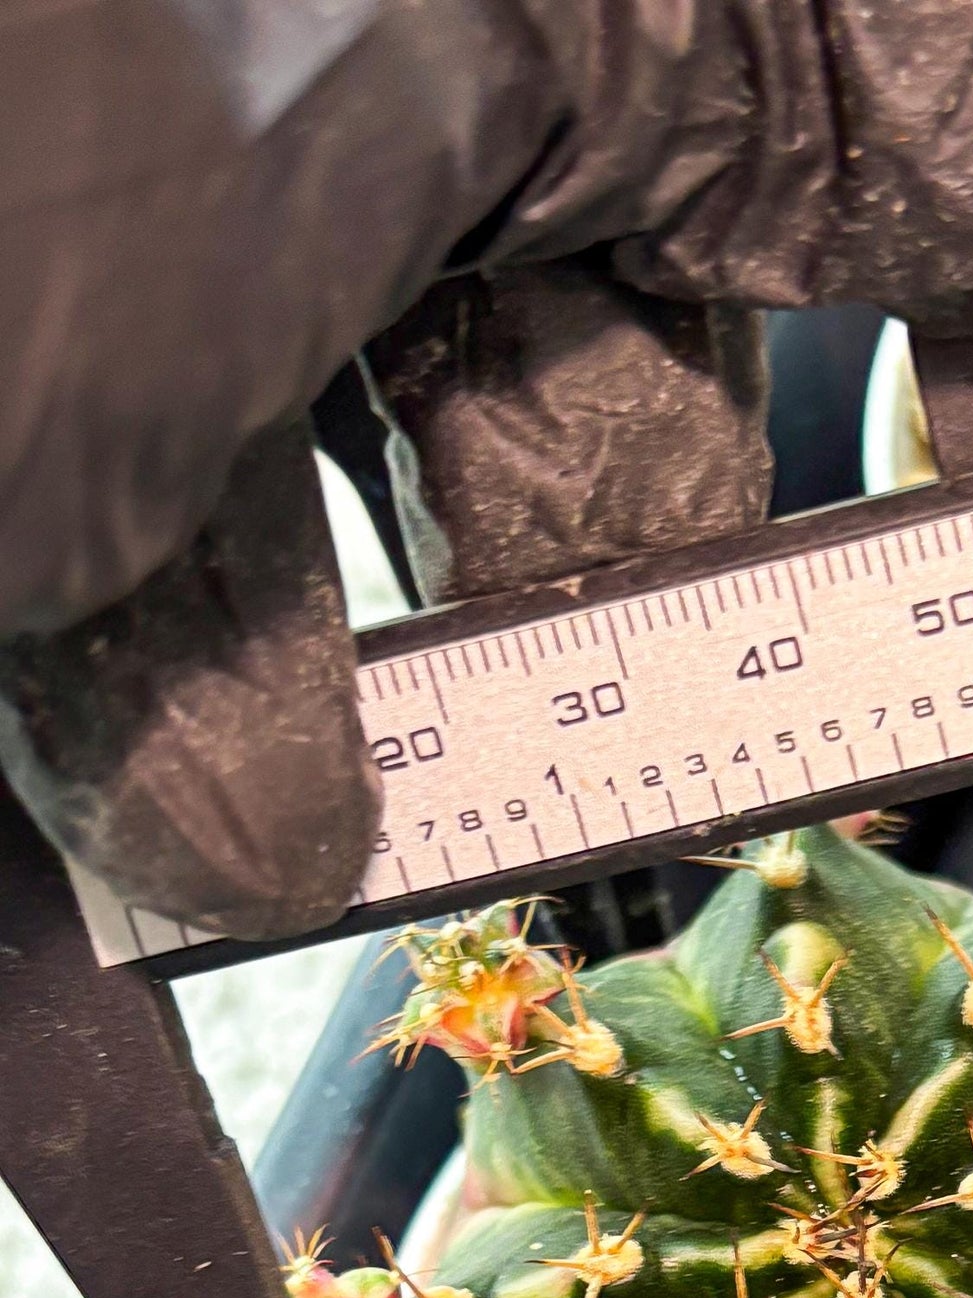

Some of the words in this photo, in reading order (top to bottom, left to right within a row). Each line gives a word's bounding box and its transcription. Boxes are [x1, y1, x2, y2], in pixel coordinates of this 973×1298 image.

[371, 725, 445, 772] 20
[551, 680, 626, 728] 30
[736, 635, 804, 681] 40
[417, 819, 436, 842] 7
[458, 809, 484, 833] 8
[504, 798, 530, 823] 9
[543, 762, 565, 797] 1
[603, 775, 618, 797] 1
[639, 764, 666, 789] 2
[684, 752, 709, 777] 3
[730, 741, 752, 765] 4
[774, 730, 797, 754] 5
[820, 718, 844, 743] 6
[869, 707, 888, 730] 7
[911, 695, 936, 720] 8
